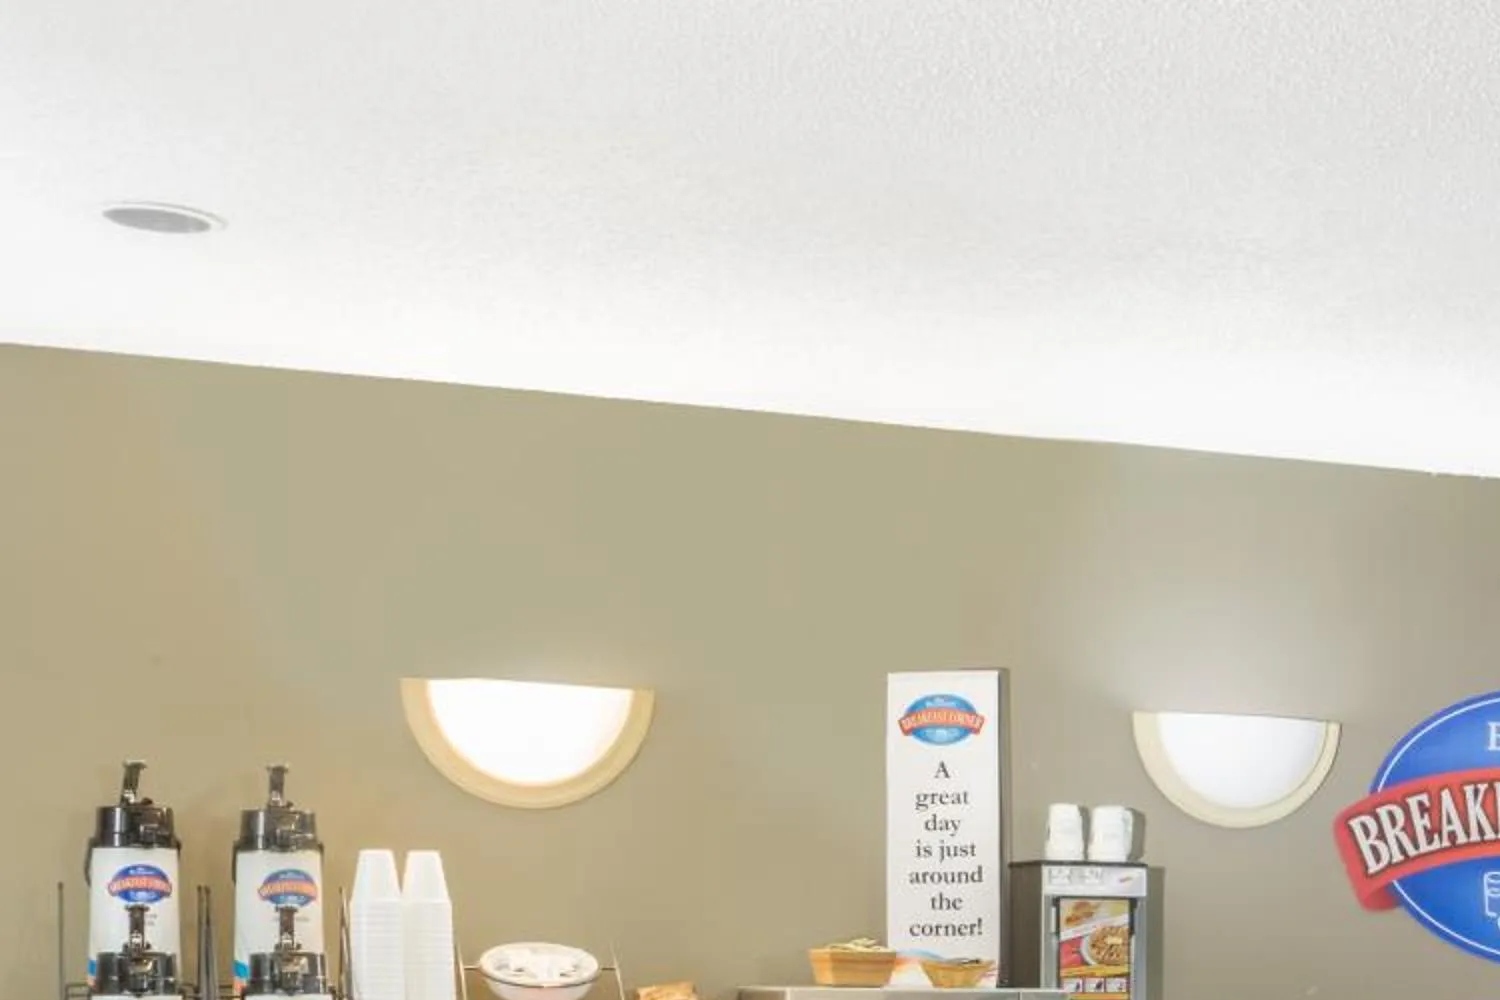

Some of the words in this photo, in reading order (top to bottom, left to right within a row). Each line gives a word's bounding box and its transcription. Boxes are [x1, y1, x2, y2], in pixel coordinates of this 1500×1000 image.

[934, 761, 950, 779] A
[915, 790, 970, 811] great
[924, 814, 961, 837] day
[915, 840, 933, 858] is
[938, 840, 977, 862] just
[908, 865, 984, 885] around
[930, 893, 964, 911] the
[909, 917, 984, 938] corner!
